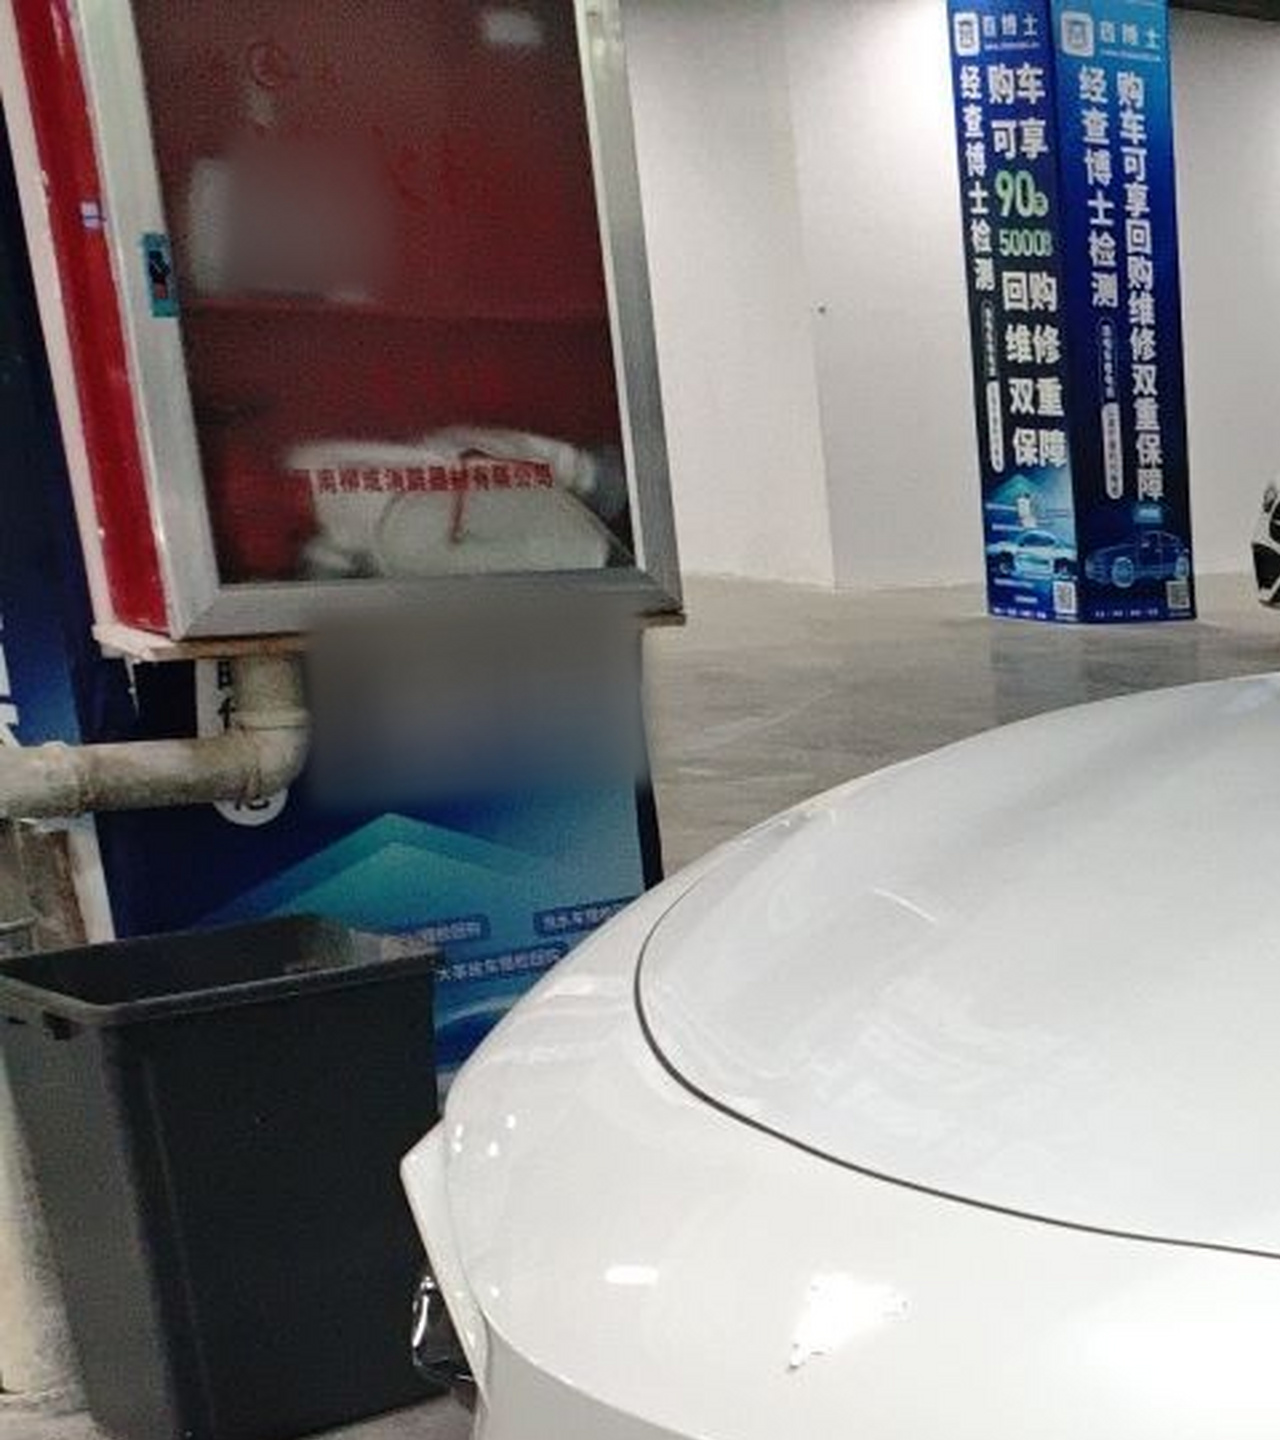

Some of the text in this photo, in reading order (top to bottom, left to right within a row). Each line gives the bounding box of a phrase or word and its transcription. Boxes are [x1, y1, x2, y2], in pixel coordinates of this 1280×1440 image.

[987, 63, 1047, 105] 购车
[991, 117, 1049, 160] 可享
[960, 65, 995, 291] 经查博士检测
[1078, 64, 1119, 309] 经查博士检测
[1001, 270, 1058, 313] 回购
[1116, 71, 1163, 501] 购车可享回购维修双重保障
[1004, 323, 1062, 365] 维修
[1007, 376, 1065, 417] 双重
[1012, 427, 1069, 468] 保障
